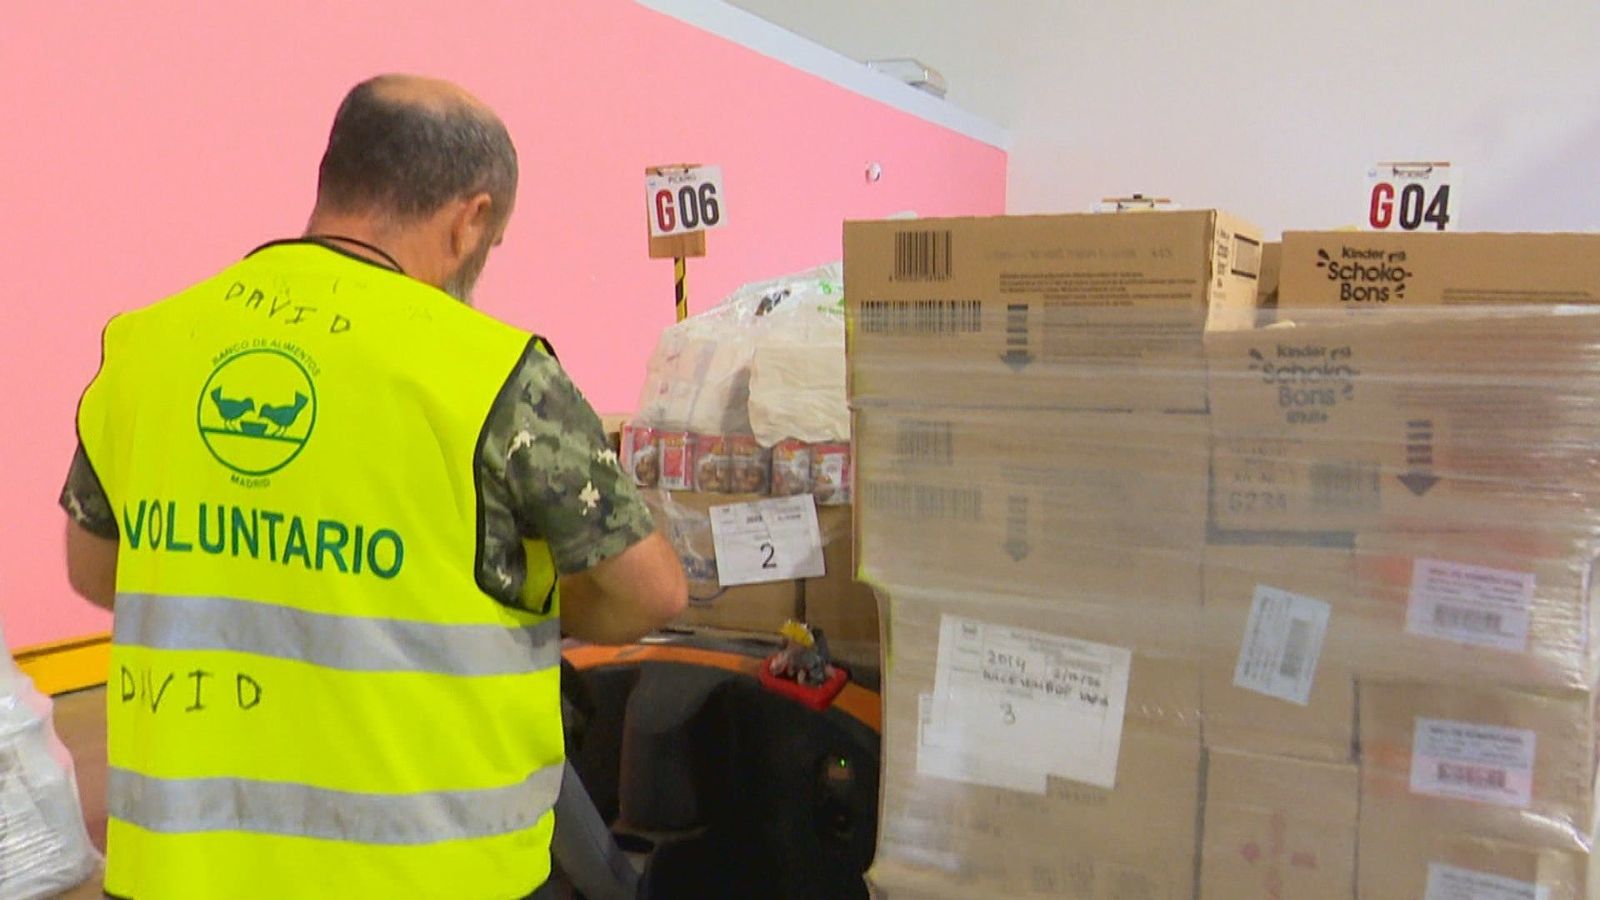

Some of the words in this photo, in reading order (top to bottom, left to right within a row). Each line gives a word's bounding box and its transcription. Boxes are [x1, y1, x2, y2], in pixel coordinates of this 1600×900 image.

[224, 280, 352, 335] DAVID
[1340, 283, 1390, 302] Bons
[211, 339, 249, 367] BANCO
[252, 338, 267, 348] DE
[269, 338, 321, 376] ALIMENTOS
[230, 473, 272, 489] MADRID
[122, 499, 405, 580] VOLUNTARIO
[760, 542, 777, 570] 2
